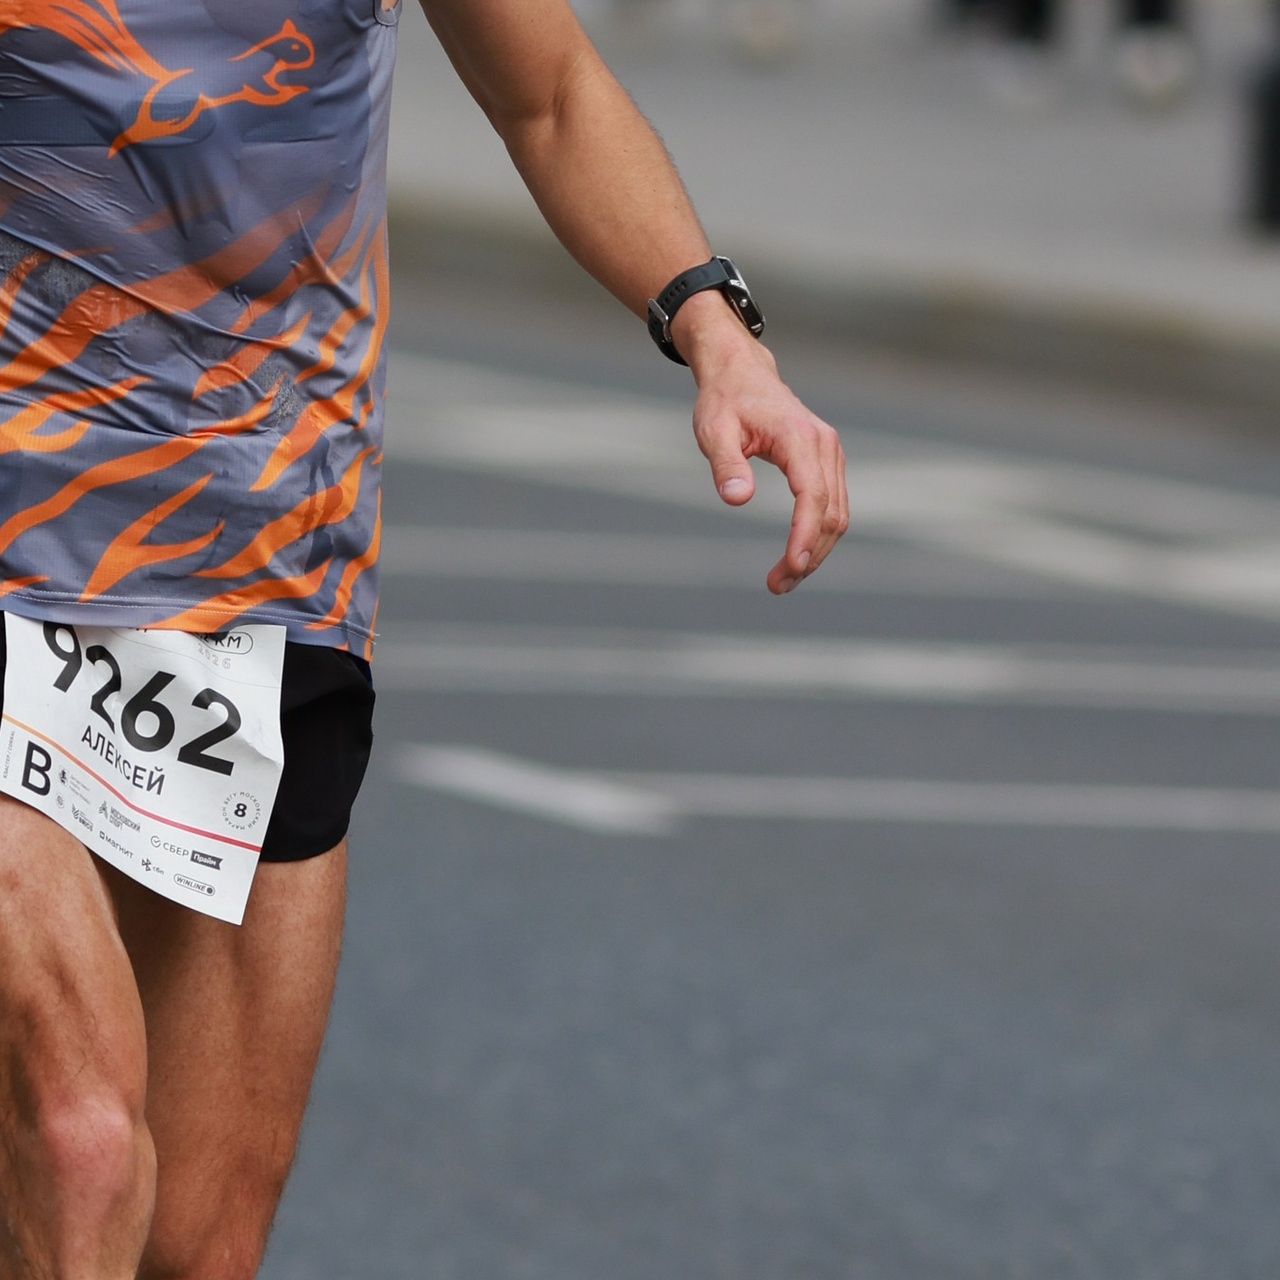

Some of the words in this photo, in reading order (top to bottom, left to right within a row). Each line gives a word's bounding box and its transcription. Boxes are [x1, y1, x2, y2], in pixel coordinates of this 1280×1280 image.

[197, 643, 232, 669] 2026
[42, 621, 242, 777] 9262
[81, 725, 167, 796] АЛЕКСЕЙ
[233, 802, 248, 818] 8
[162, 842, 190, 858] СБЕР
[176, 876, 207, 892] WINLINE
